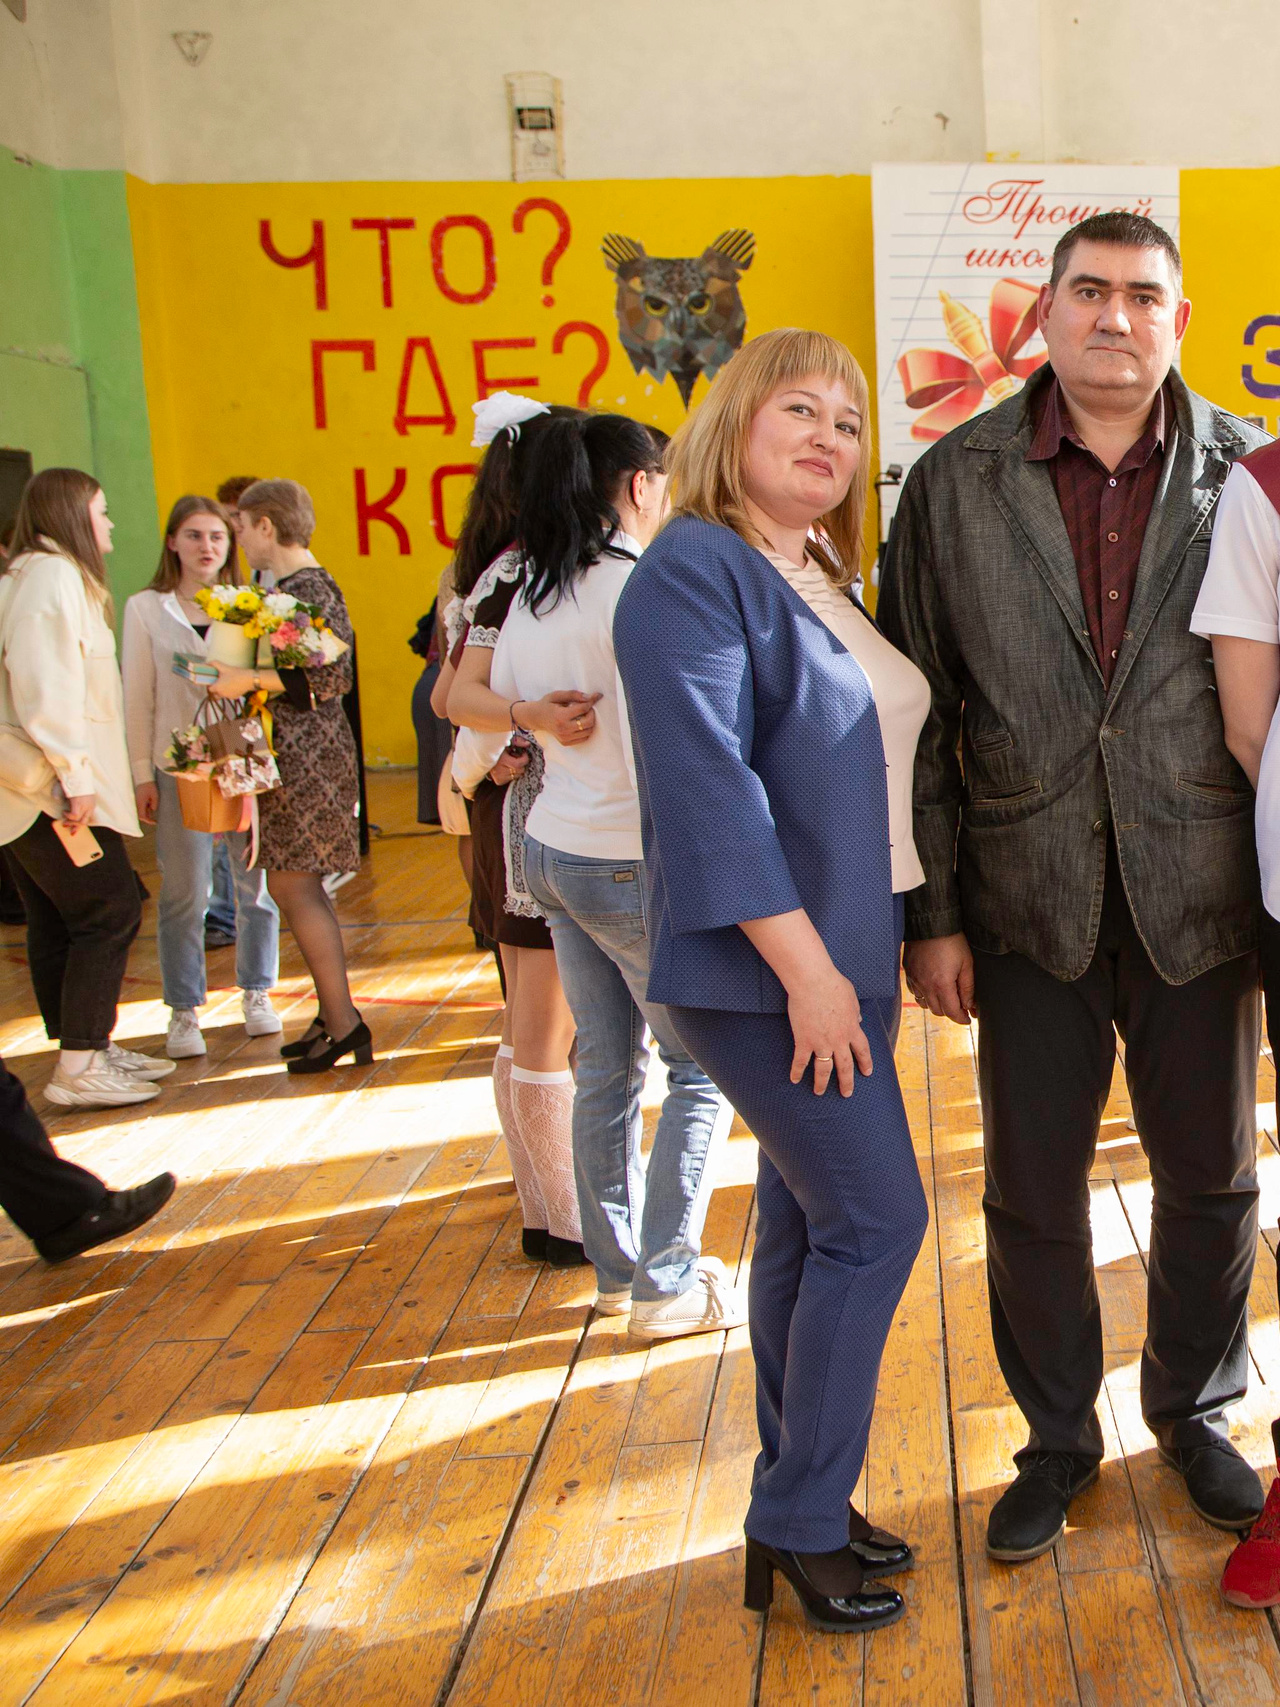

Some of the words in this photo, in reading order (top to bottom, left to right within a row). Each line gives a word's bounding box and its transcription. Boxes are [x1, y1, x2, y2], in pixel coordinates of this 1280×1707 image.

[258, 197, 572, 311] ЧТО?
[963, 178, 1152, 240] Прощй
[310, 320, 610, 436] ГДЕ?
